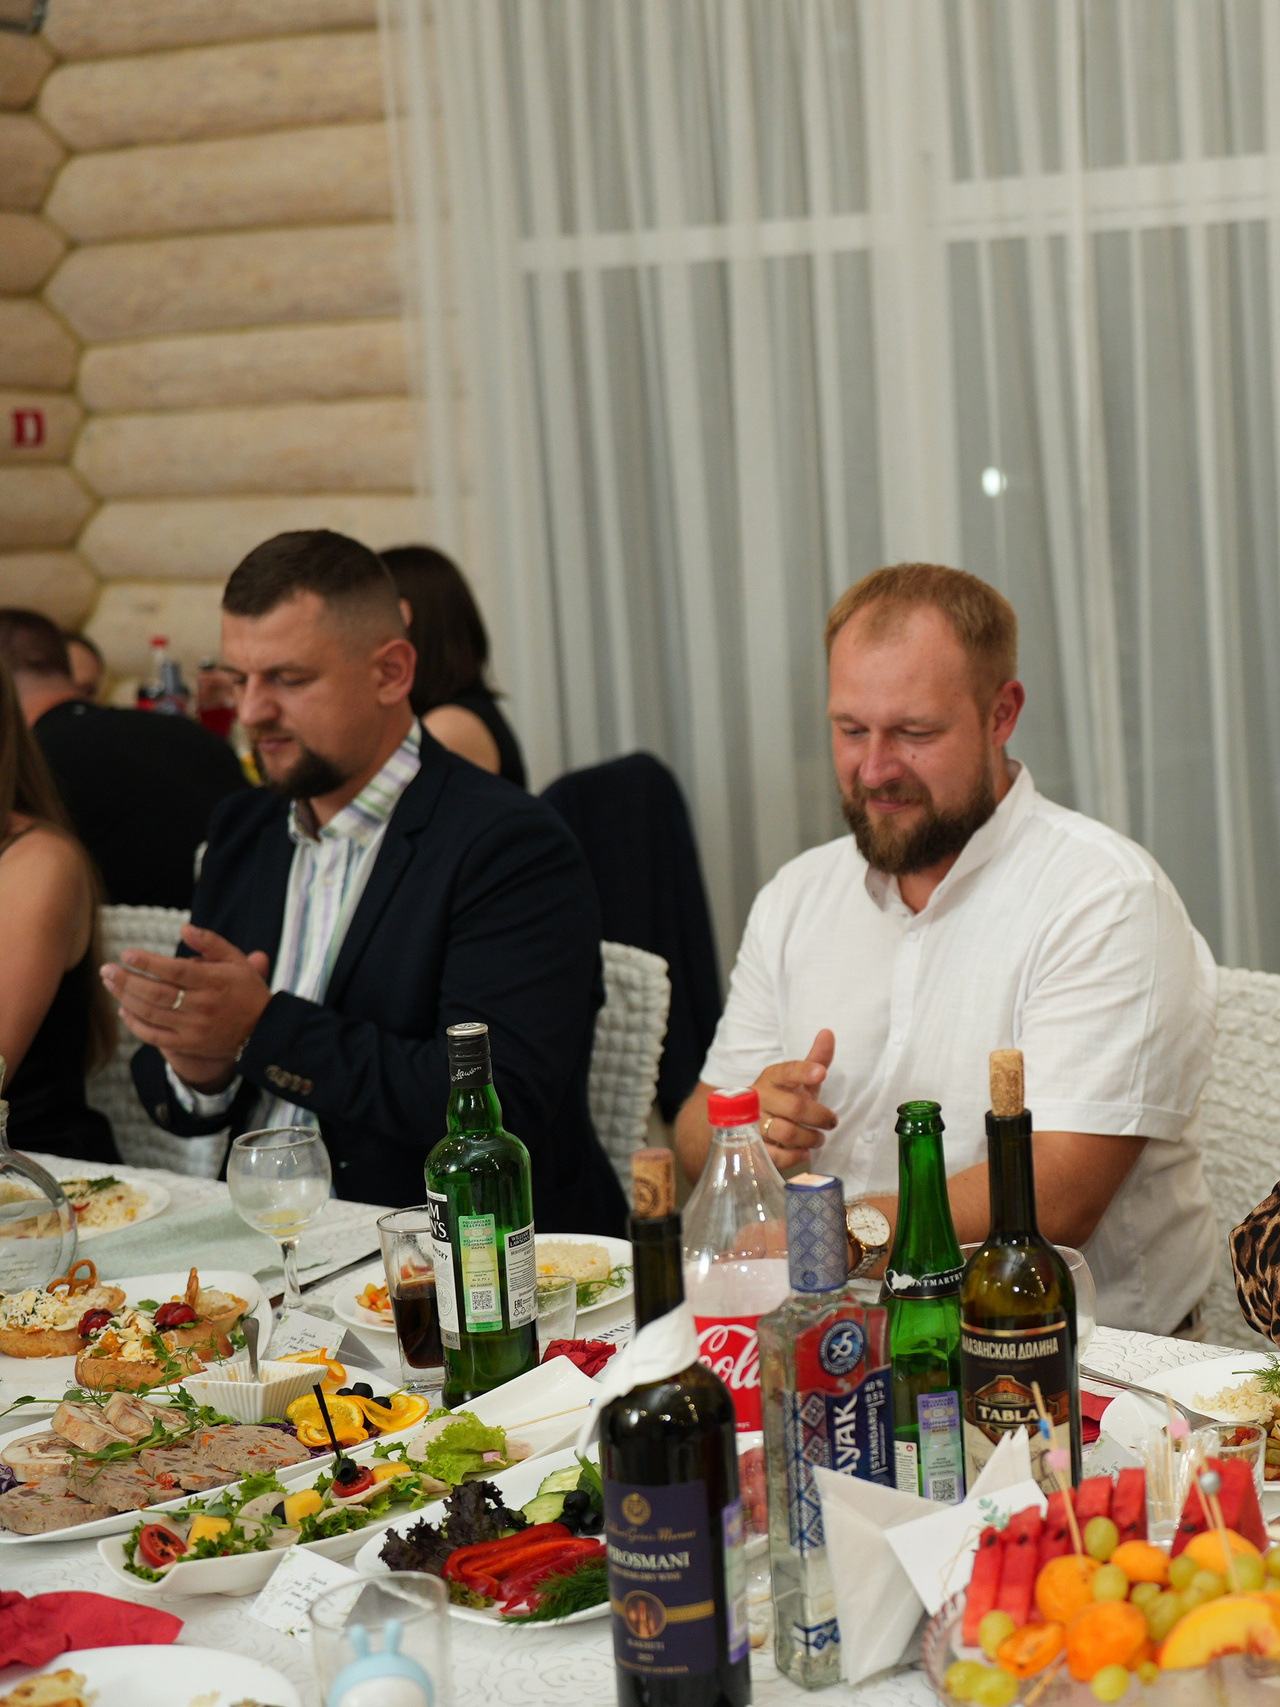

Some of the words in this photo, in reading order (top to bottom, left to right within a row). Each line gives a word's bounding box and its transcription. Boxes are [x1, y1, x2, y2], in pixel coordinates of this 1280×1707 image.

[1017, 1336, 1059, 1360] ДОЛИНА
[978, 1404, 1040, 1423] TABLA
[868, 1407, 880, 1470] STANDARD
